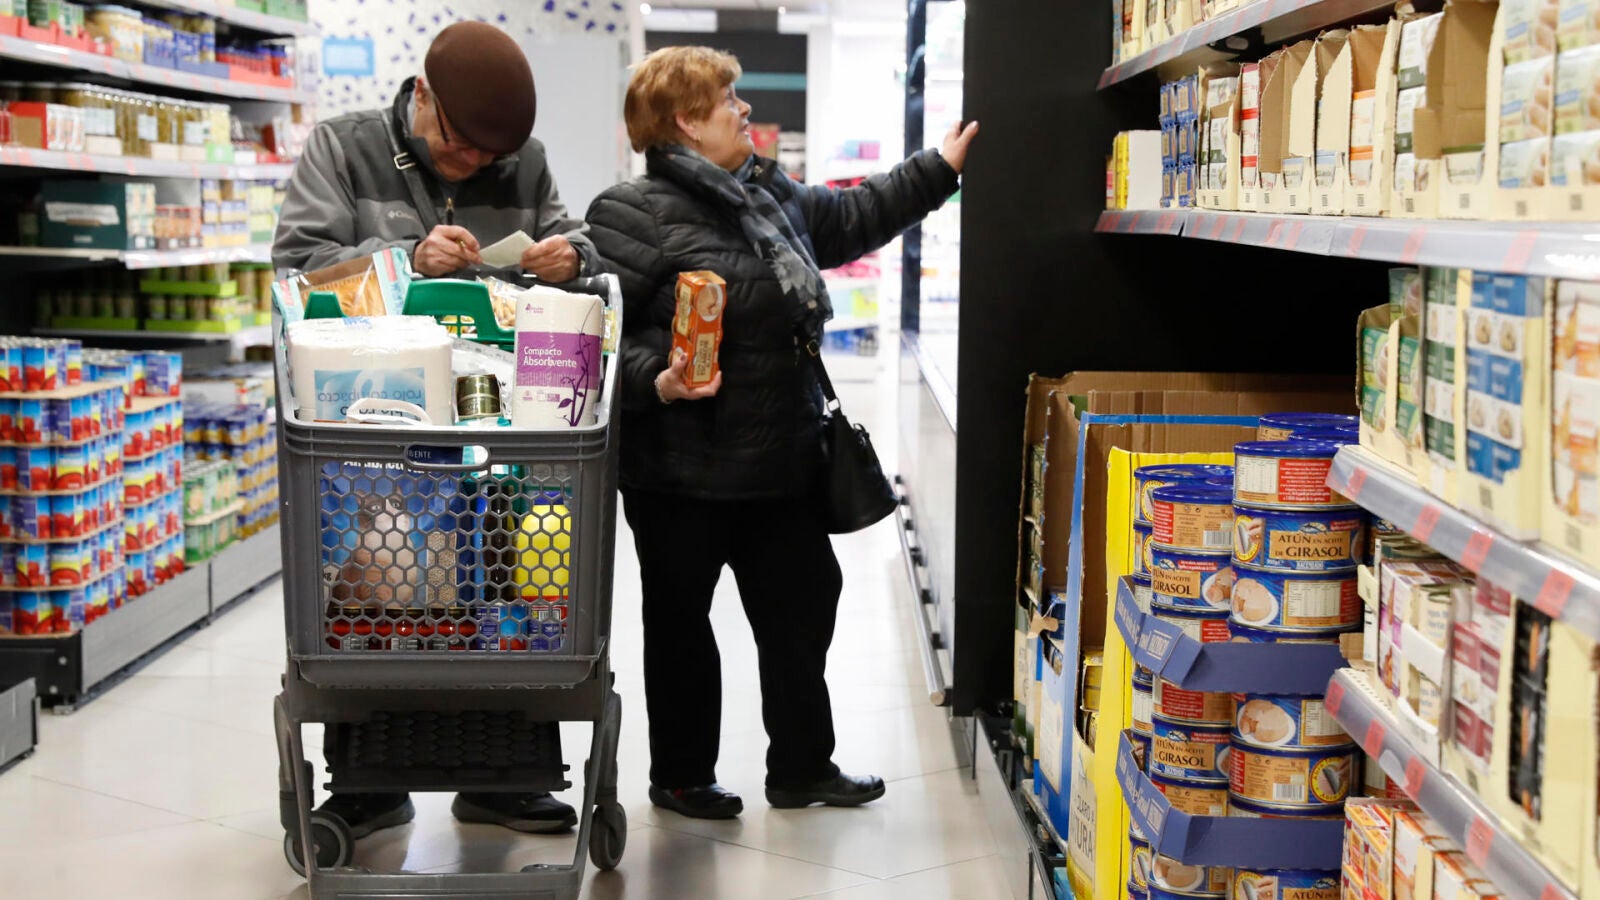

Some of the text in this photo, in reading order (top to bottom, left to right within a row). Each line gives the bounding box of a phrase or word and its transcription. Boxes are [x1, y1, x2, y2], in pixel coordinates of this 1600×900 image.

[523, 346, 562, 356] Compacto
[1278, 533, 1311, 544] ATÚN
[1286, 546, 1345, 558] GIRASOL
[1153, 580, 1193, 595] GIRASOL
[1159, 750, 1207, 768] GIRASOL
